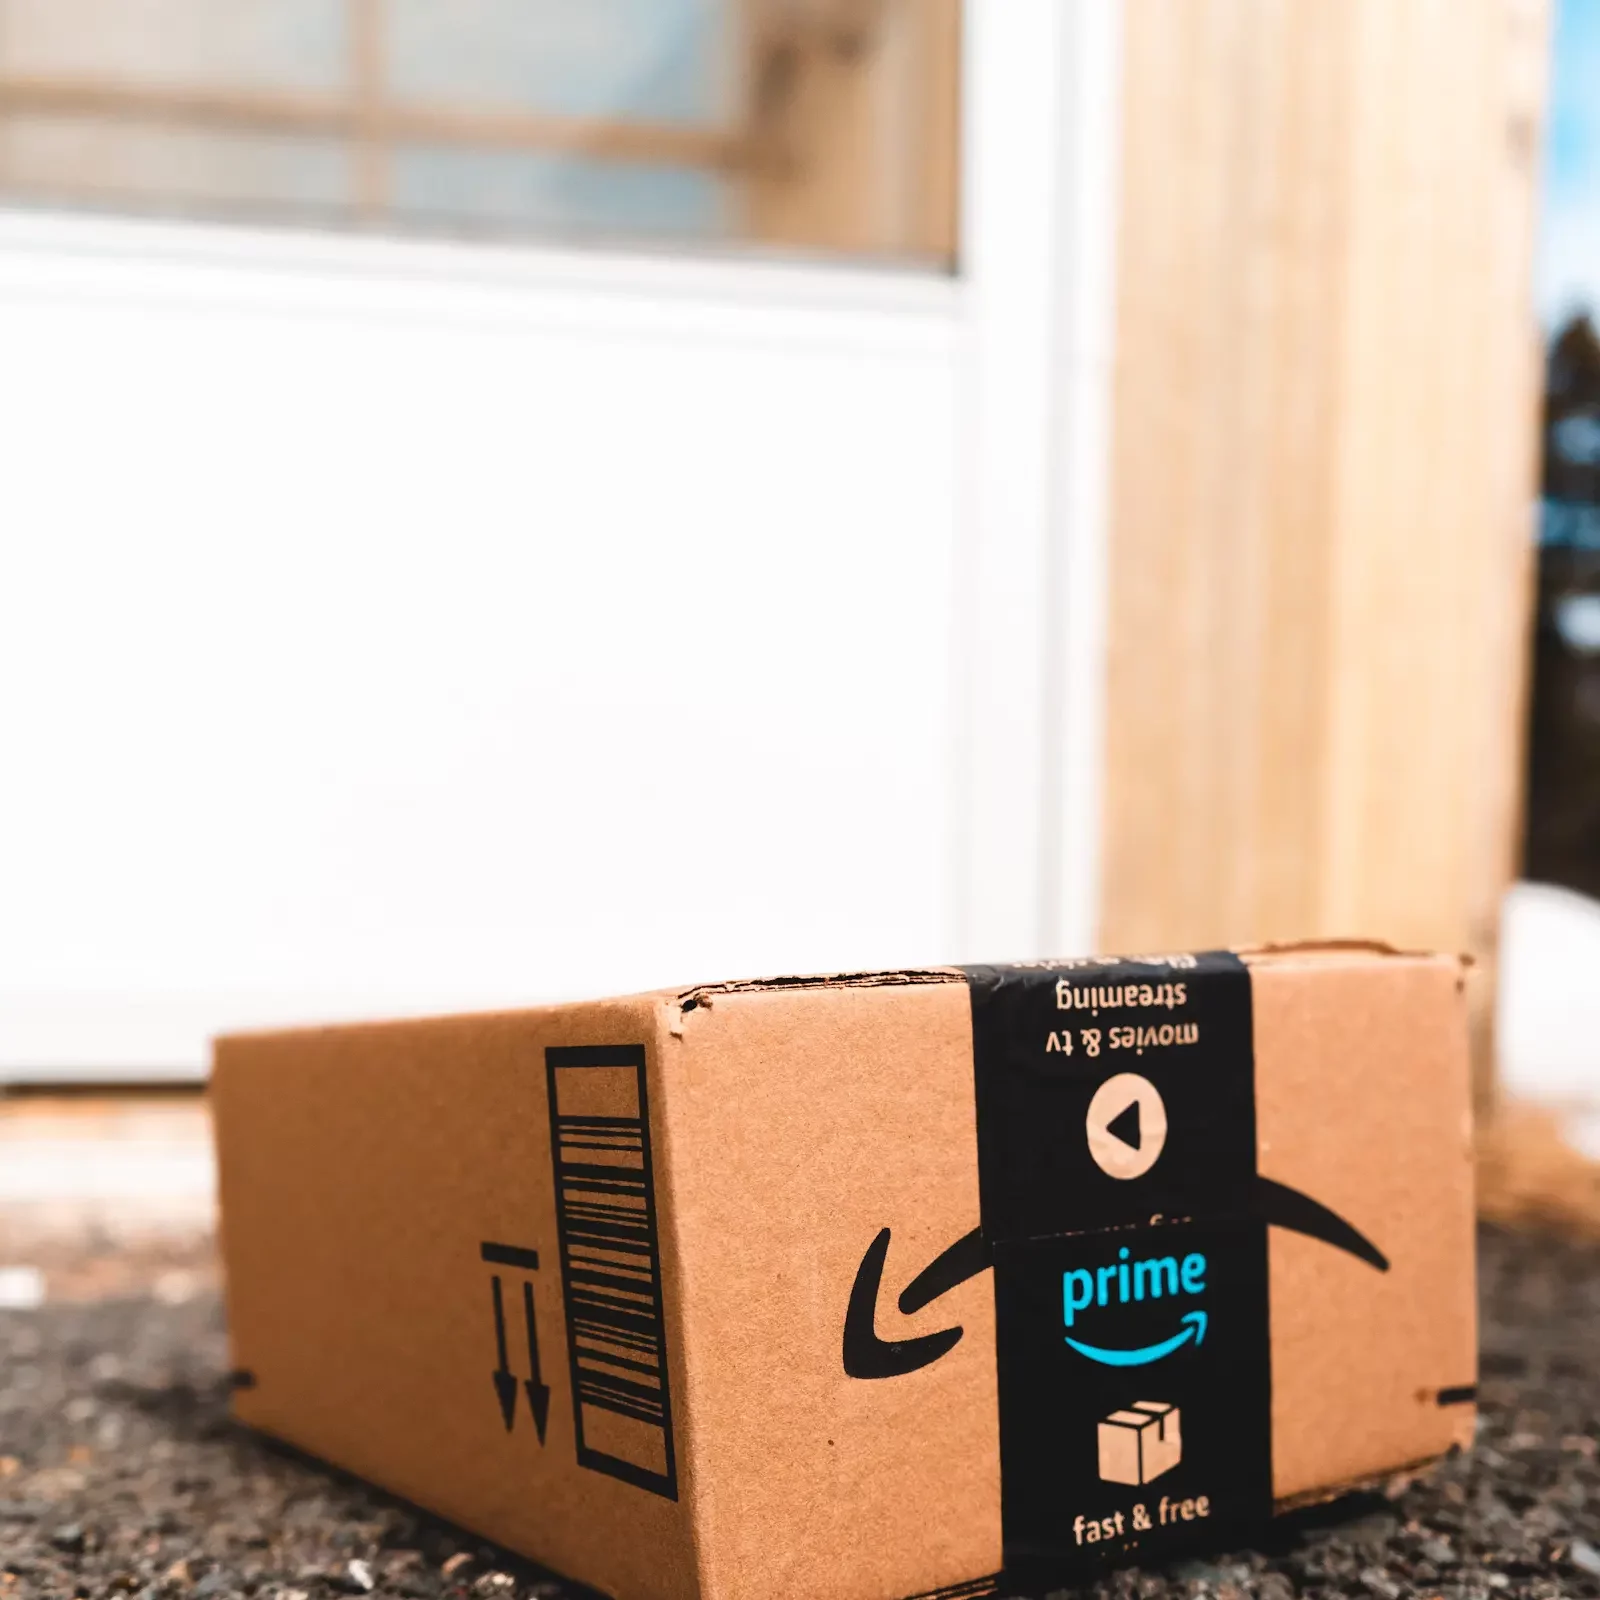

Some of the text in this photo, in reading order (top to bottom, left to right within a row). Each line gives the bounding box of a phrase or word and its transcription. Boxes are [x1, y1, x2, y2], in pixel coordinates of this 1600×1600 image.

[1055, 979, 1187, 1017] streaming
[1045, 1022, 1199, 1058] movies & tv
[1062, 1246, 1207, 1328] prime
[1072, 1495, 1210, 1547] fast & free
